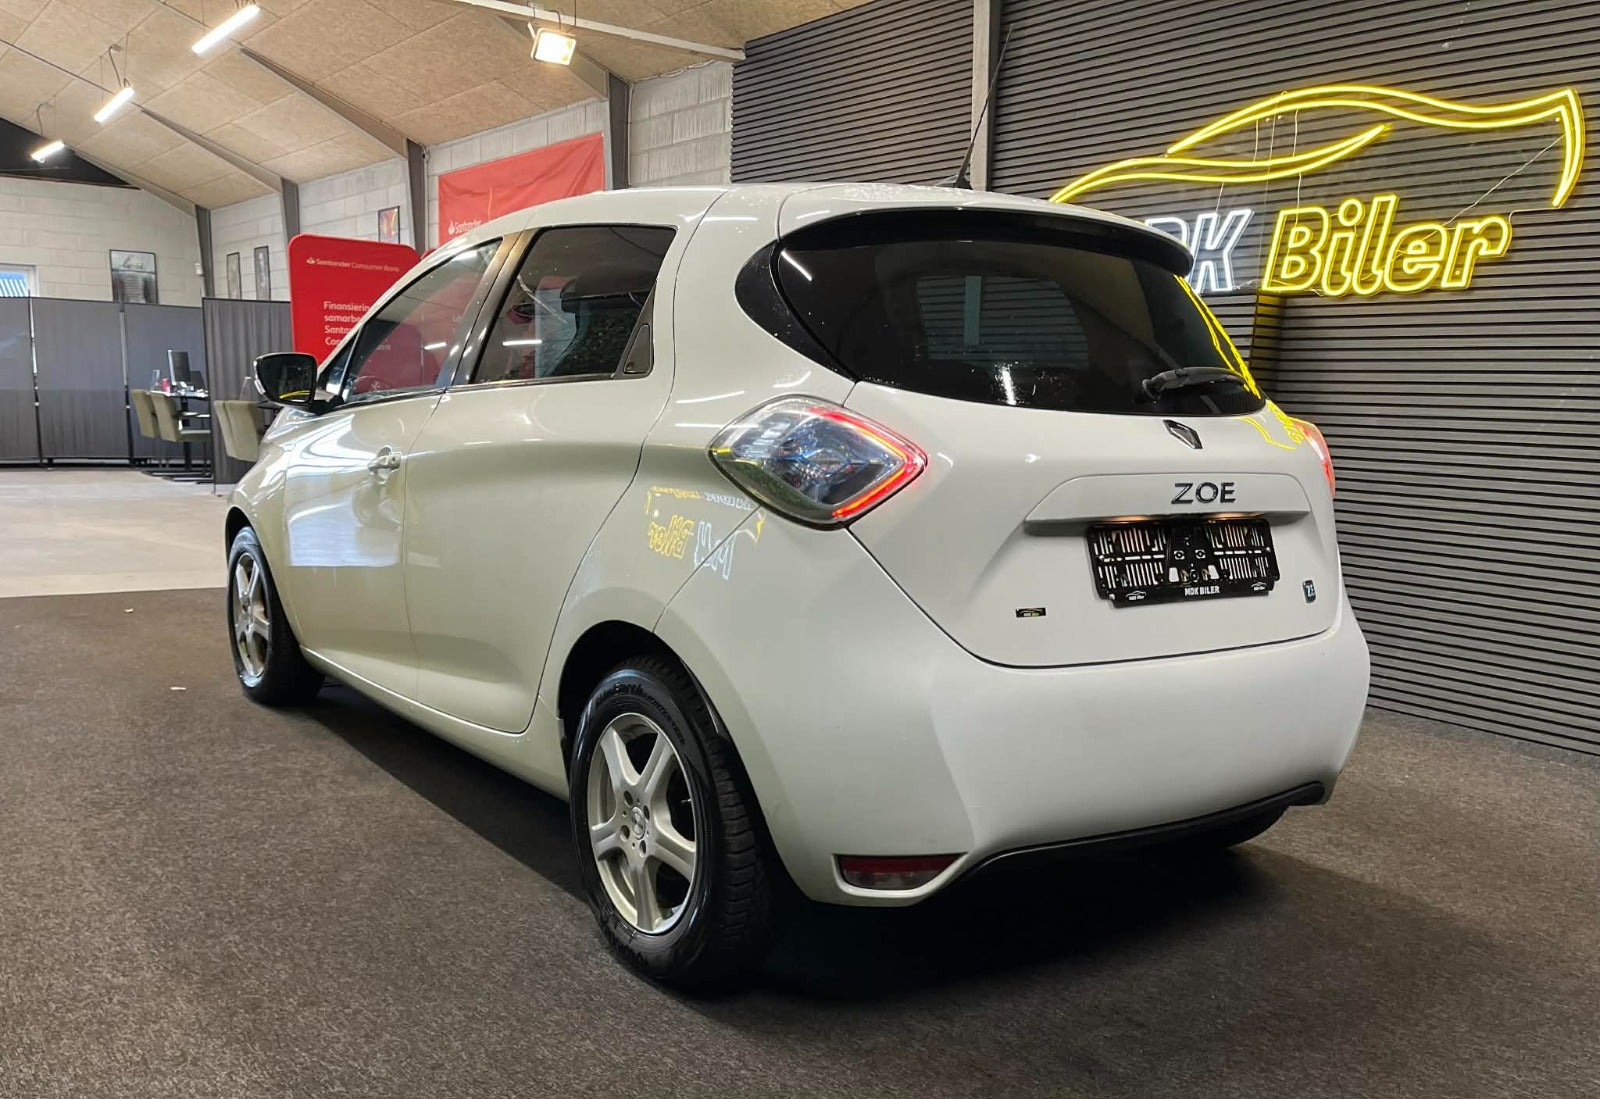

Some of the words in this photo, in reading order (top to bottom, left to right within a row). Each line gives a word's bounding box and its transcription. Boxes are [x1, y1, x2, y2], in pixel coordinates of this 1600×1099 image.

[1261, 194, 1512, 296] Biler
[316, 258, 351, 268] Santander
[1171, 482, 1236, 504] ZOE
[1184, 586, 1199, 596] MDK
[1199, 585, 1221, 595] BILER
